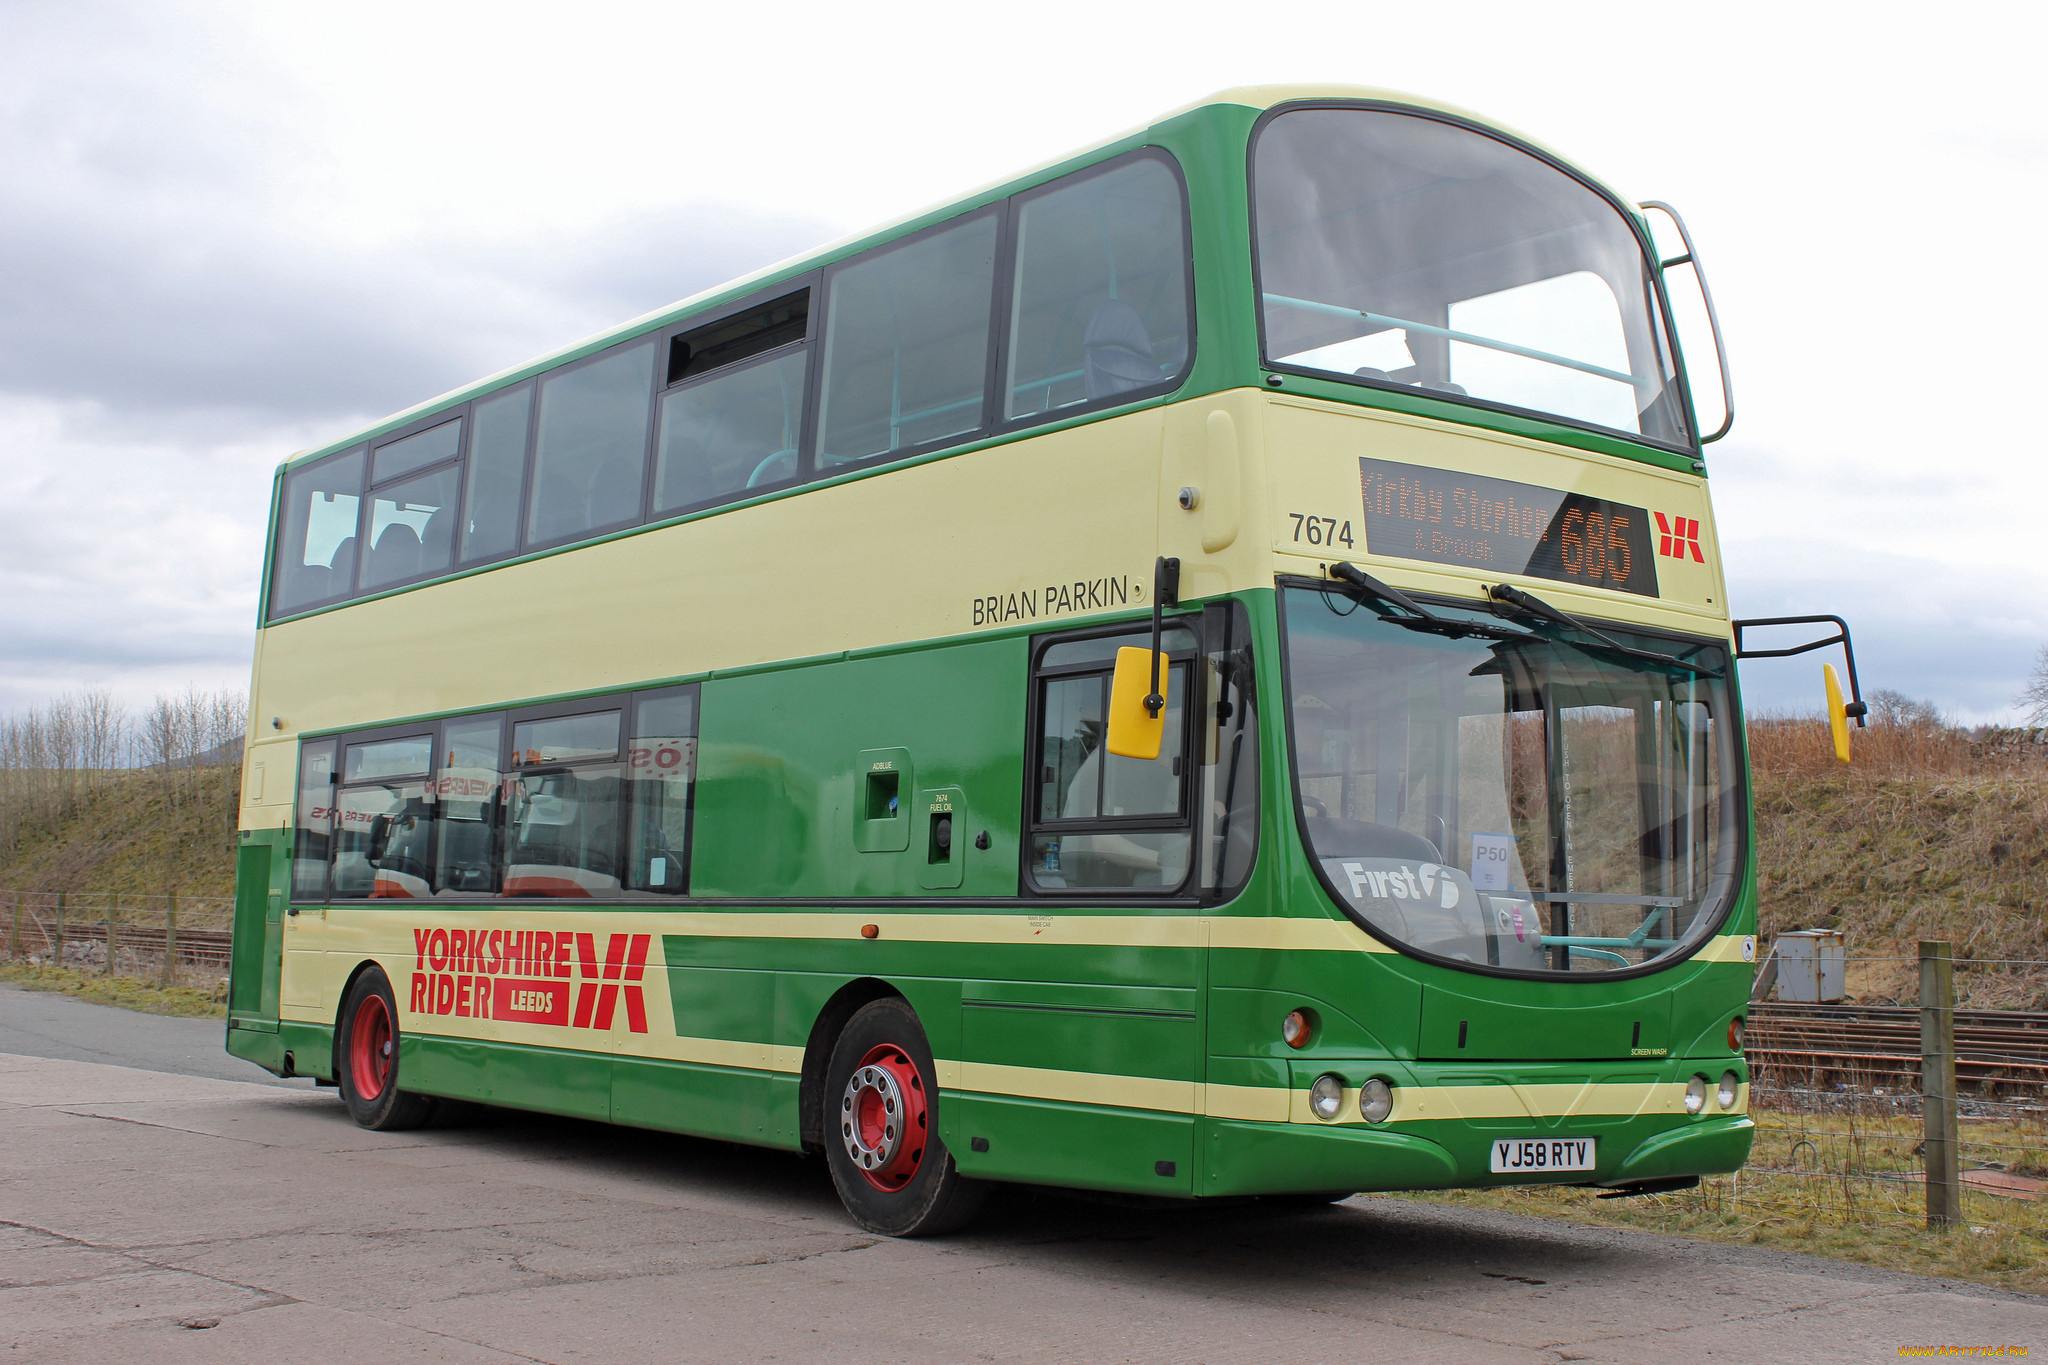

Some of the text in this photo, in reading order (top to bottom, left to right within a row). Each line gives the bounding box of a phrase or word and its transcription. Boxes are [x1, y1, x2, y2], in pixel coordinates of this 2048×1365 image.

[1360, 470, 1549, 541] Kirkby Stephen
[1289, 512, 1354, 549] 7674
[1432, 530, 1494, 561] Brough
[1561, 508, 1631, 582] 685
[973, 574, 1128, 626] BRIAN PARKIN
[872, 761, 893, 770] ADBLUE
[929, 803, 953, 811] FUEL OIL
[1476, 845, 1507, 861] P50
[1342, 862, 1421, 899] First
[413, 928, 574, 978] YORKSHIRE
[410, 972, 492, 1019] RIDER
[510, 989, 554, 1014] LEEDS
[1631, 1047, 1668, 1056] SCREEN WASH
[1498, 1142, 1587, 1168] YJ58 RTV
